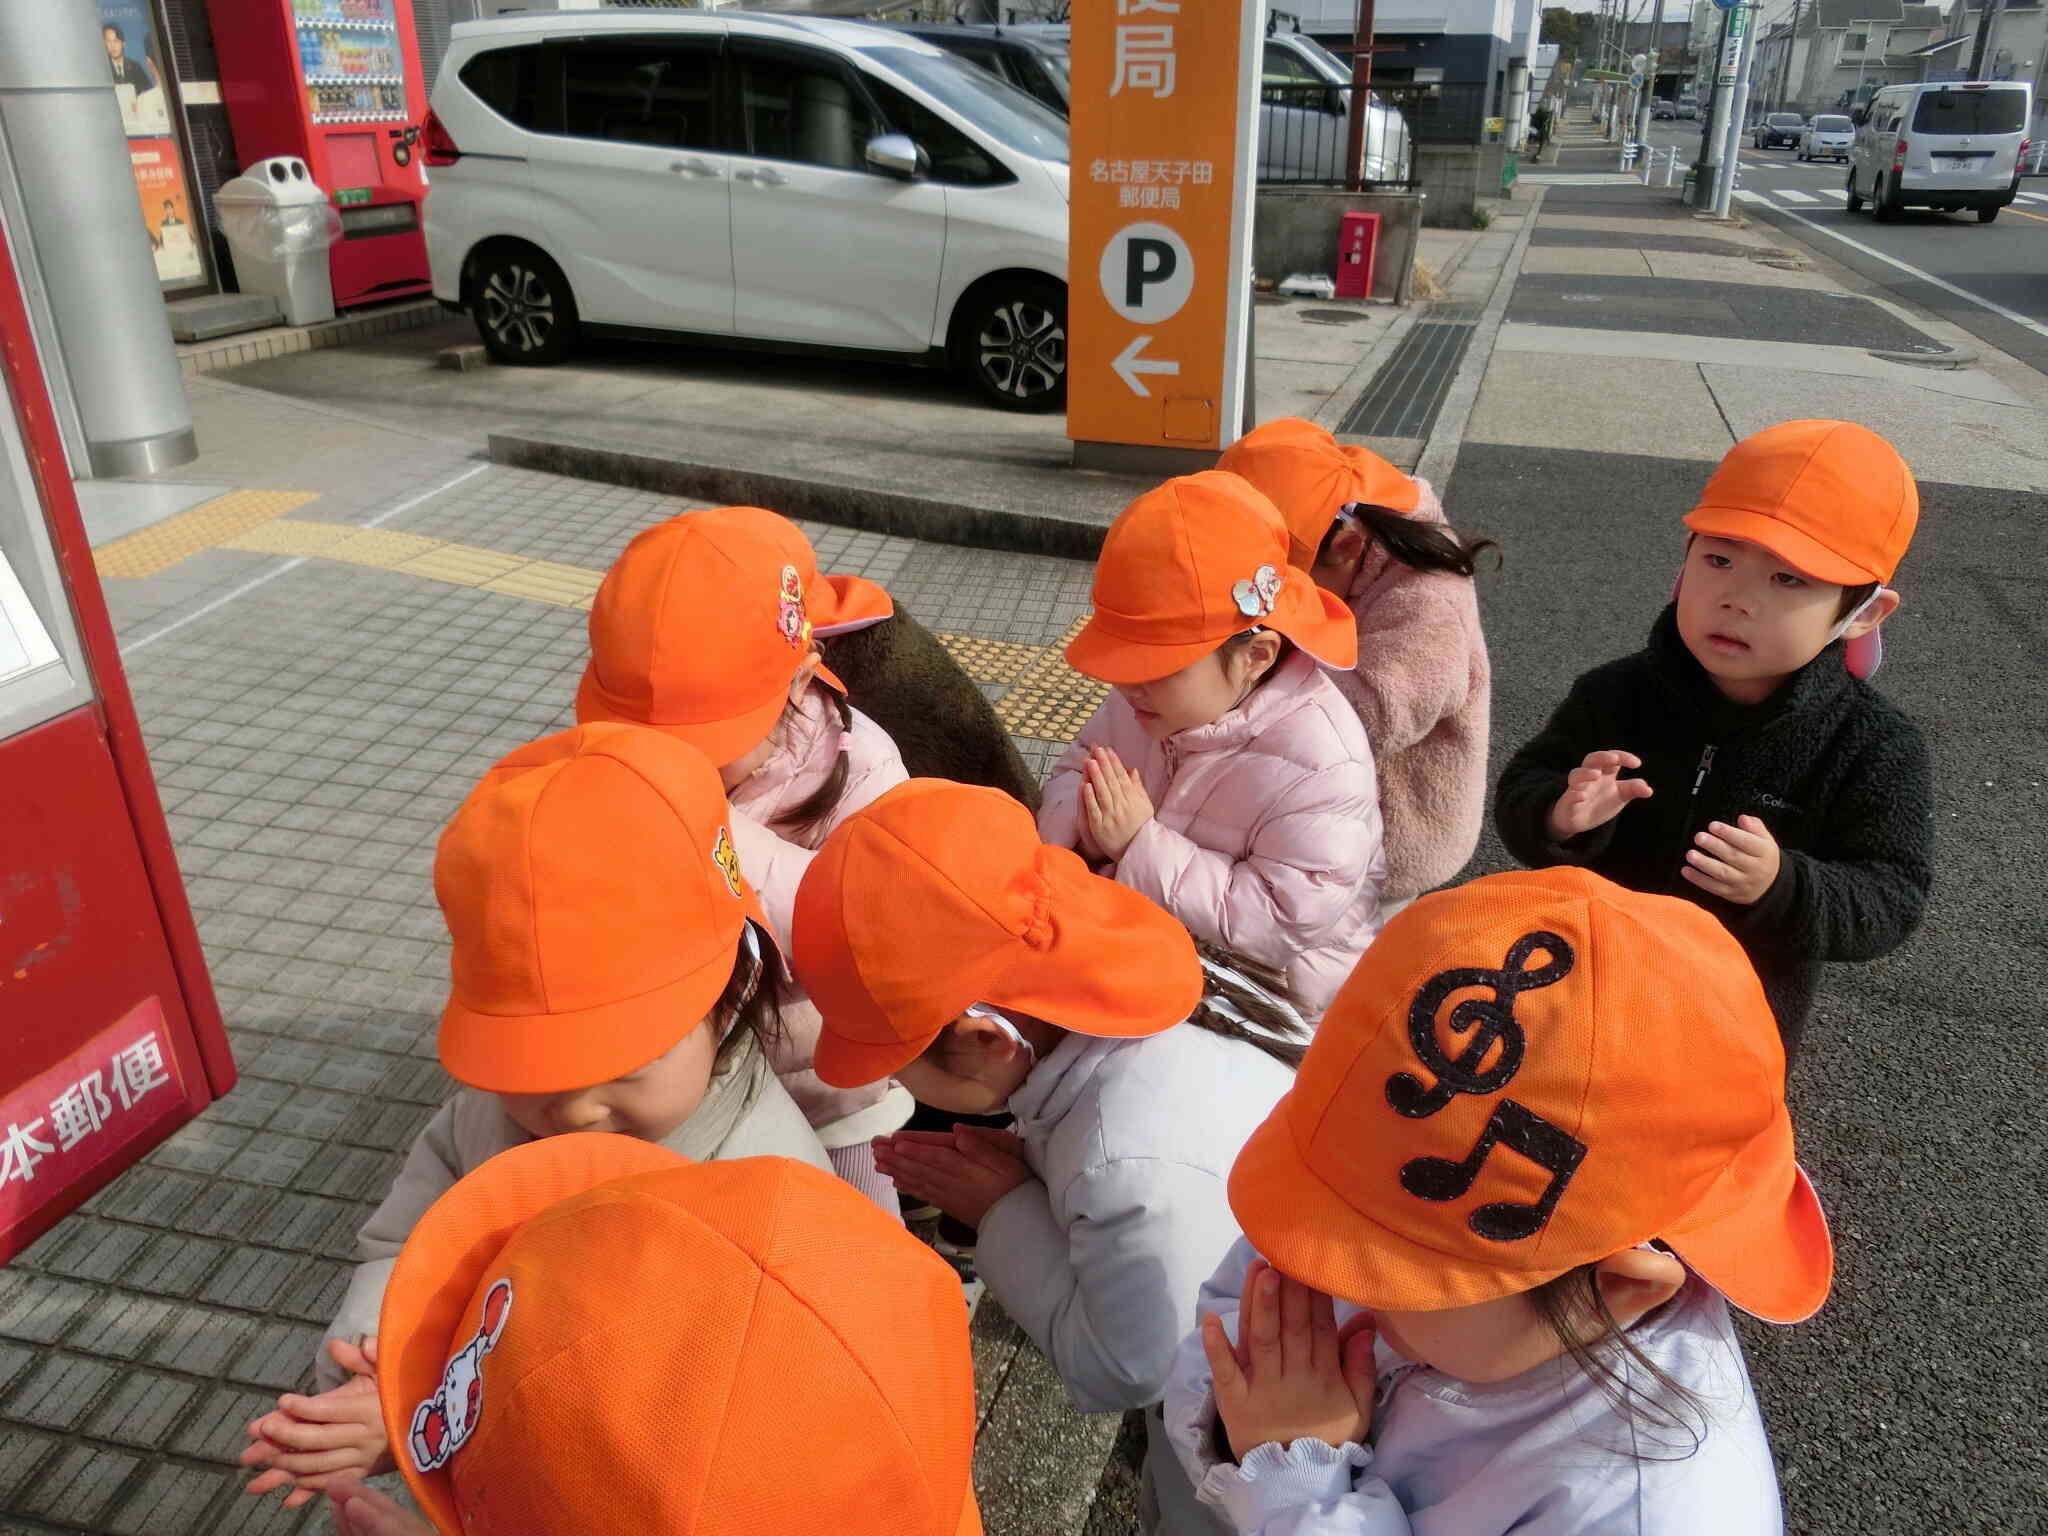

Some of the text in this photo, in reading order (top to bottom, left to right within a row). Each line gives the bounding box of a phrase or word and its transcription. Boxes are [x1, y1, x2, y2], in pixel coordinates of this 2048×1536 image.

[1109, 0, 1181, 98] 局
[1089, 158, 1213, 185] 名古屋天子田
[1119, 186, 1181, 209] 郵便局
[1126, 237, 1177, 307] P
